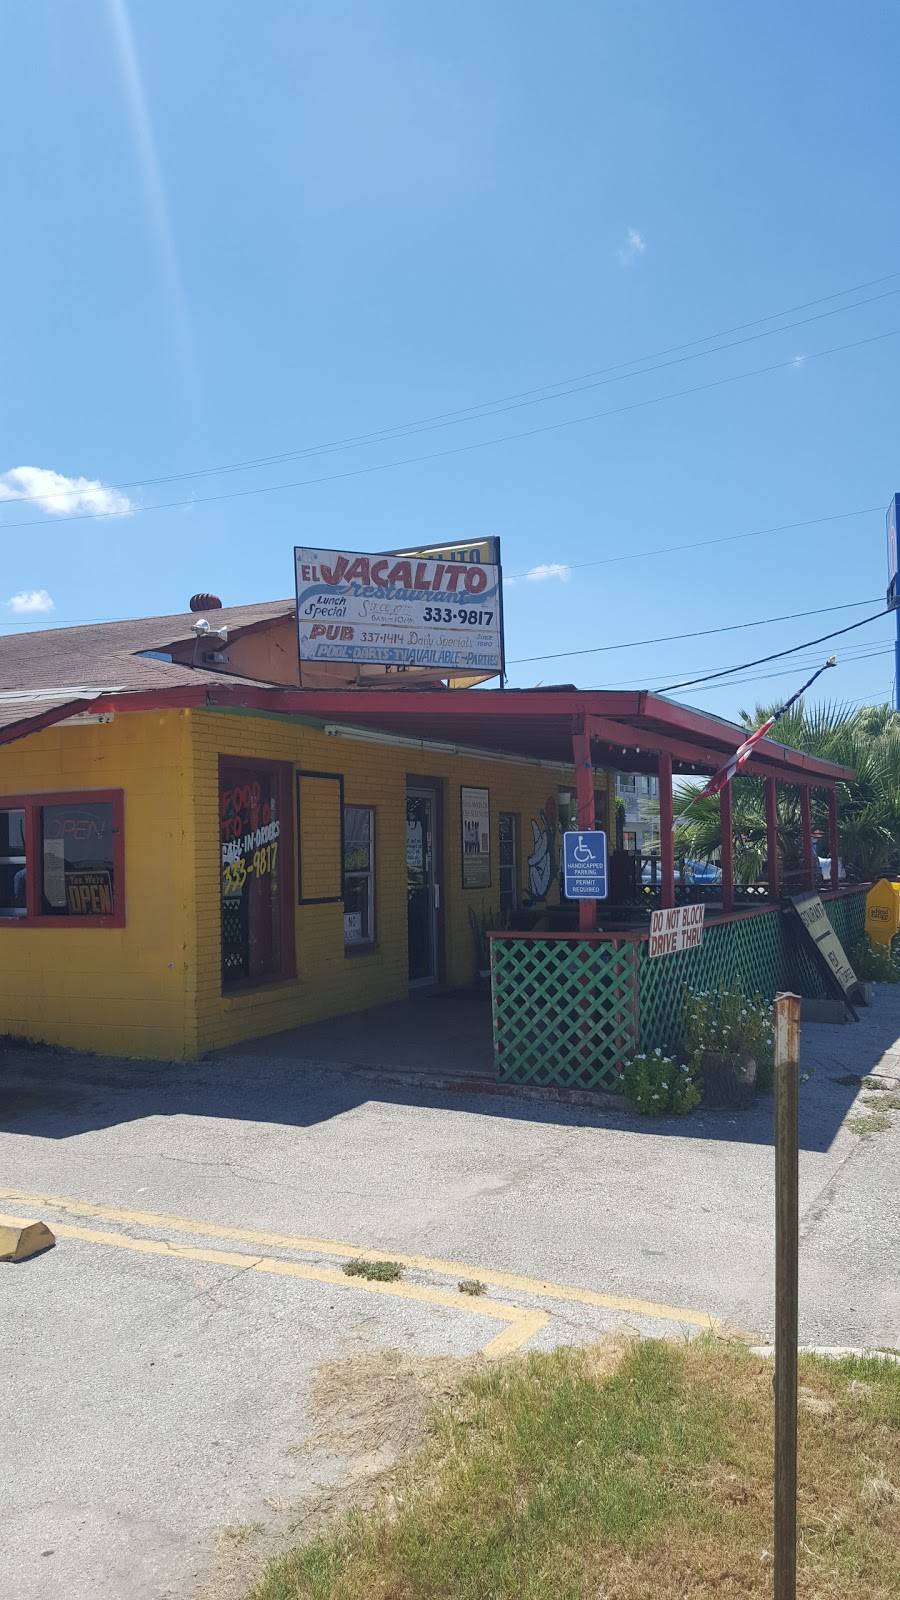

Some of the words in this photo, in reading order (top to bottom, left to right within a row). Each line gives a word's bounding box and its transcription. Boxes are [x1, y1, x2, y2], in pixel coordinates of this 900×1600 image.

[301, 565, 320, 581] EL
[320, 555, 487, 593] JACALITO
[304, 603, 347, 619] Special
[316, 595, 346, 606] Lunch
[309, 624, 354, 640] PUB
[68, 885, 111, 914] OPEN
[652, 912, 664, 933] DO
[665, 909, 681, 931] NOT
[683, 905, 704, 927] BLOCK
[651, 932, 678, 957] DRIVE
[682, 927, 702, 949] THRU
